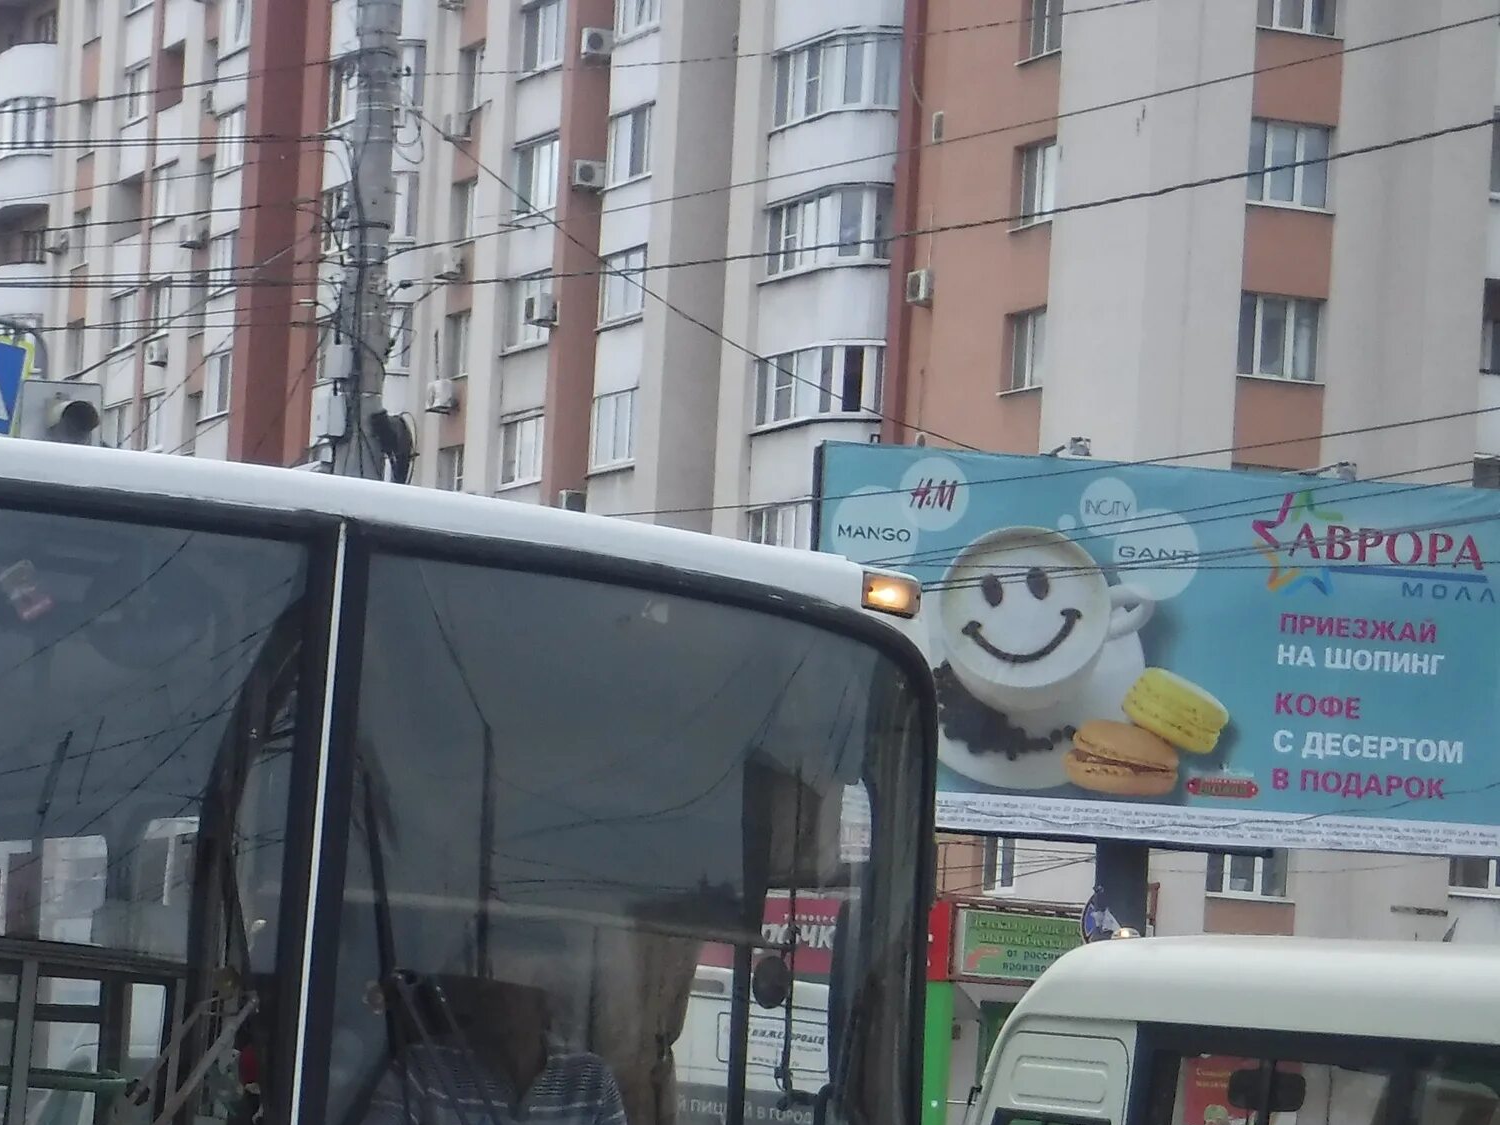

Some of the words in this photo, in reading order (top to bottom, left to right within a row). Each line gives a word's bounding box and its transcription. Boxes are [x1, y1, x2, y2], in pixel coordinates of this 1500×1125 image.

[909, 478, 958, 511] H&M
[1084, 499, 1133, 517] INCITY
[837, 523, 911, 543] MANGO
[1288, 522, 1484, 570] АВРОРА
[1118, 545, 1197, 561] GANT
[1280, 612, 1437, 643] ПРИЕЗЖАЙ
[1277, 644, 1316, 667] НА
[1324, 647, 1445, 675] ШОПИНГ
[1275, 692, 1361, 719] КОФЕ
[1273, 729, 1294, 752] С
[1301, 731, 1464, 764] ДЕСЕРТОМ
[1272, 768, 1289, 790] В
[1301, 769, 1445, 800] ПОДАРОК
[1006, 949, 1018, 959] от
[756, 1106, 766, 1119] В
